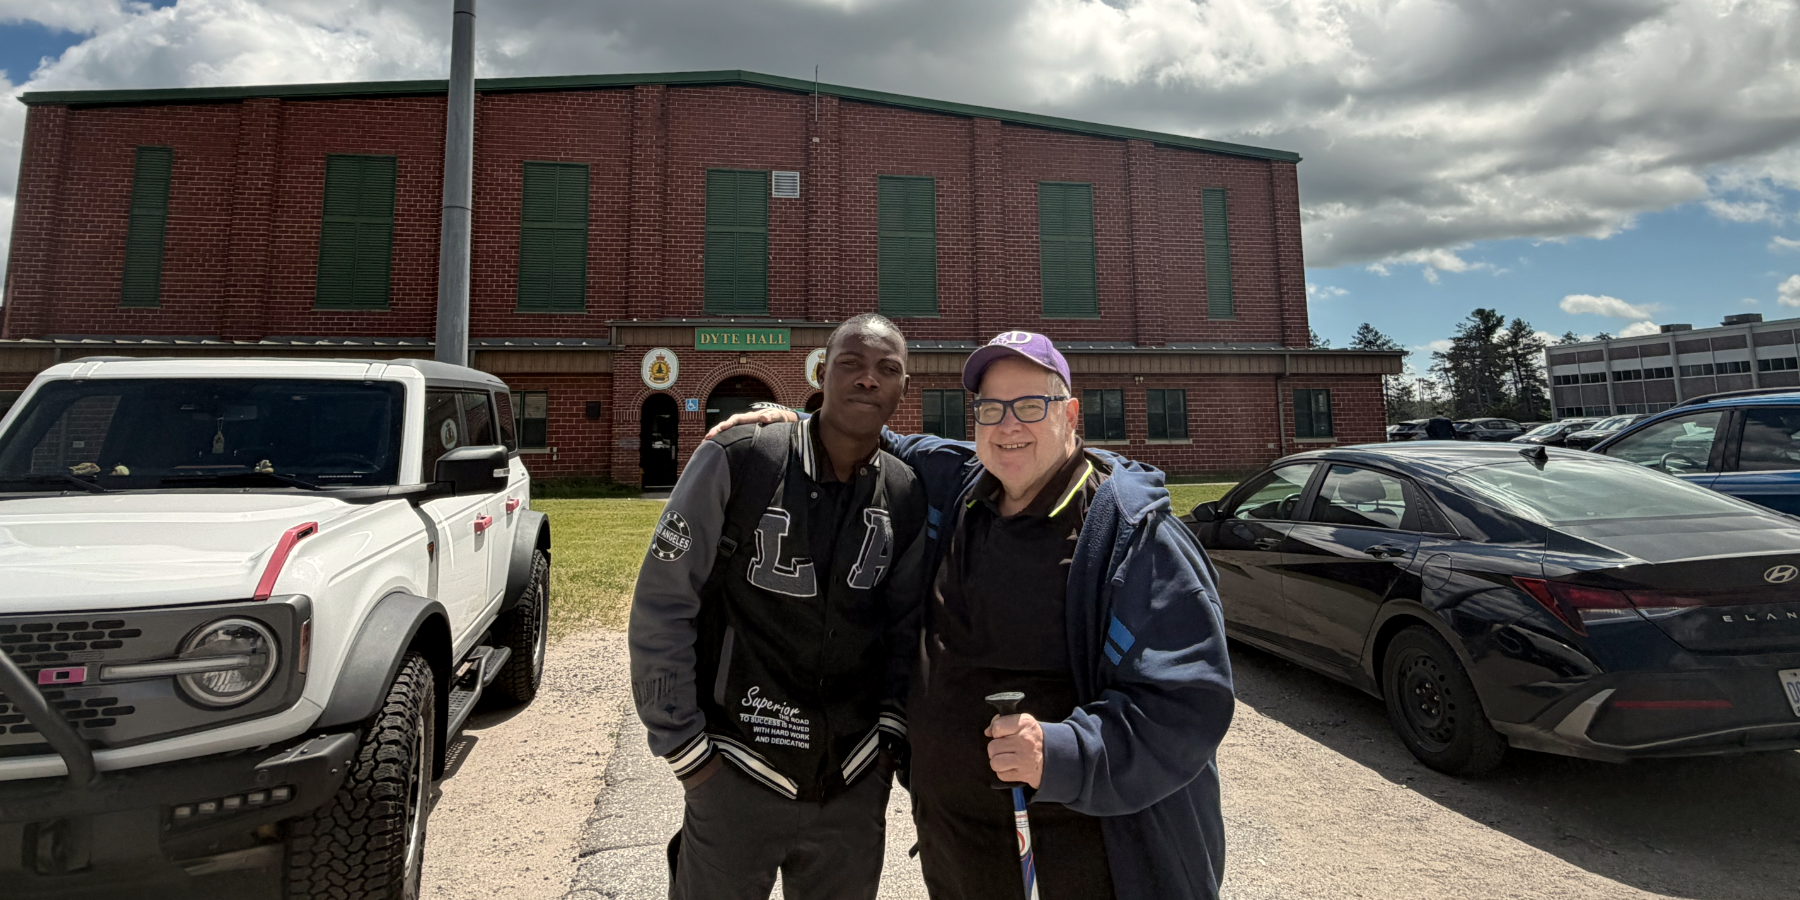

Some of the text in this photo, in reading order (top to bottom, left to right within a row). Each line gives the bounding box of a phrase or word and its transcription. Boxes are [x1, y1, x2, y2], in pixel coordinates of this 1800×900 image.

[700, 333, 787, 345] DYTE HALL
[660, 528, 690, 549] ANGELES
[747, 507, 894, 598] L A
[741, 686, 800, 716] Superior
[750, 716, 780, 726] SUCCESS
[788, 723, 810, 732] PAVED
[778, 713, 810, 725] THE ROAD
[753, 726, 810, 740] WITH HARD WORK
[755, 735, 810, 749] AND DEDICATION
